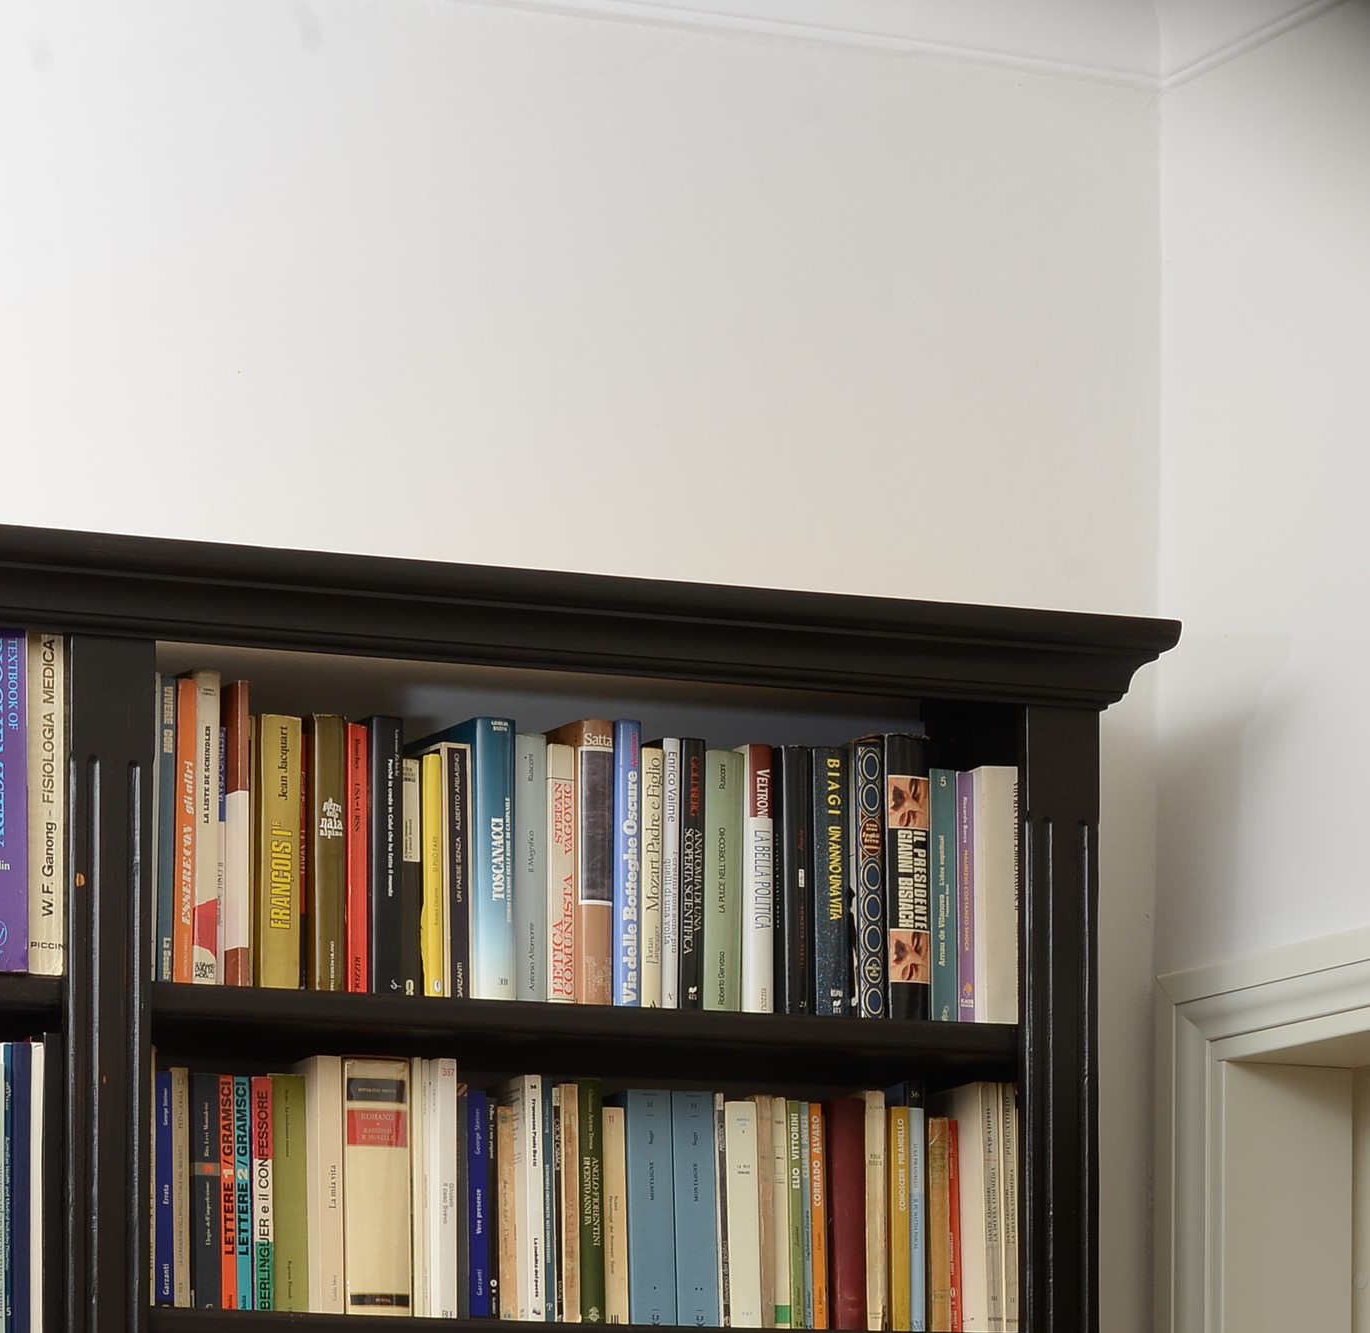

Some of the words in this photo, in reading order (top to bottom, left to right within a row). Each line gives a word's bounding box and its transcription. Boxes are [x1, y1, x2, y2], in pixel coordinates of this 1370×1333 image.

[623, 771, 638, 835] Oscure
[827, 758, 841, 819] BIAGI
[897, 830, 911, 872] GIANNI
[913, 830, 926, 842] IL
[623, 837, 639, 921] Botteghe
[914, 849, 927, 929] PRESIDENTE
[623, 924, 637, 969] delle
[623, 971, 637, 1003] Via
[257, 1091, 269, 1189] CONFESSORE
[791, 1113, 799, 1160] VITTORINI
[260, 1193, 268, 1204] il
[792, 1167, 800, 1189] ELIO
[814, 1159, 822, 1207] CORRADO
[224, 1180, 235, 1256] LETTERE
[258, 1218, 271, 1310] BERLINGUER
